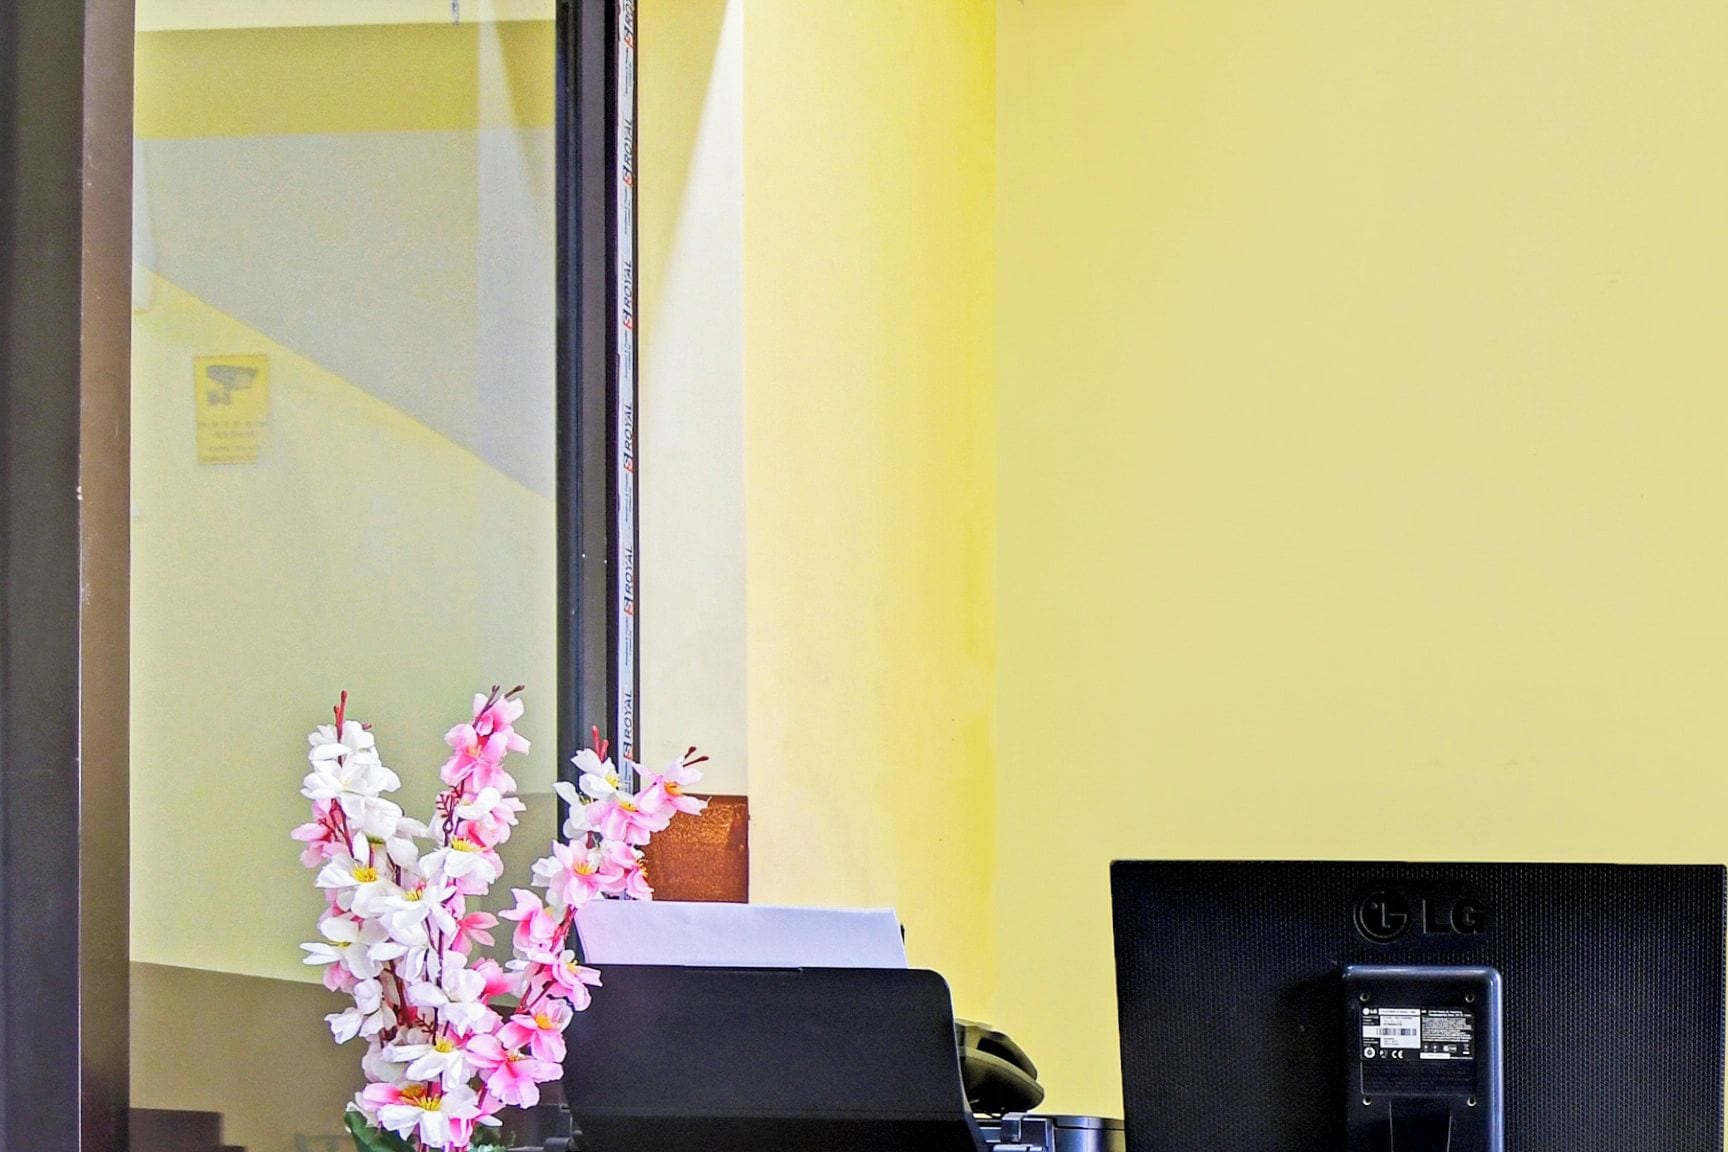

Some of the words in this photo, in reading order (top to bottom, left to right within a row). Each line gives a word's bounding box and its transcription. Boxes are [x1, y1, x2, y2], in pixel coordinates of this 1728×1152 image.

[622, 119, 633, 166] ROYAL
[623, 261, 633, 308] ROYAL
[624, 403, 634, 452] ROYAL
[624, 545, 634, 595] ROYAL
[623, 690, 633, 739] ROYAL
[1421, 898, 1488, 935] LG
